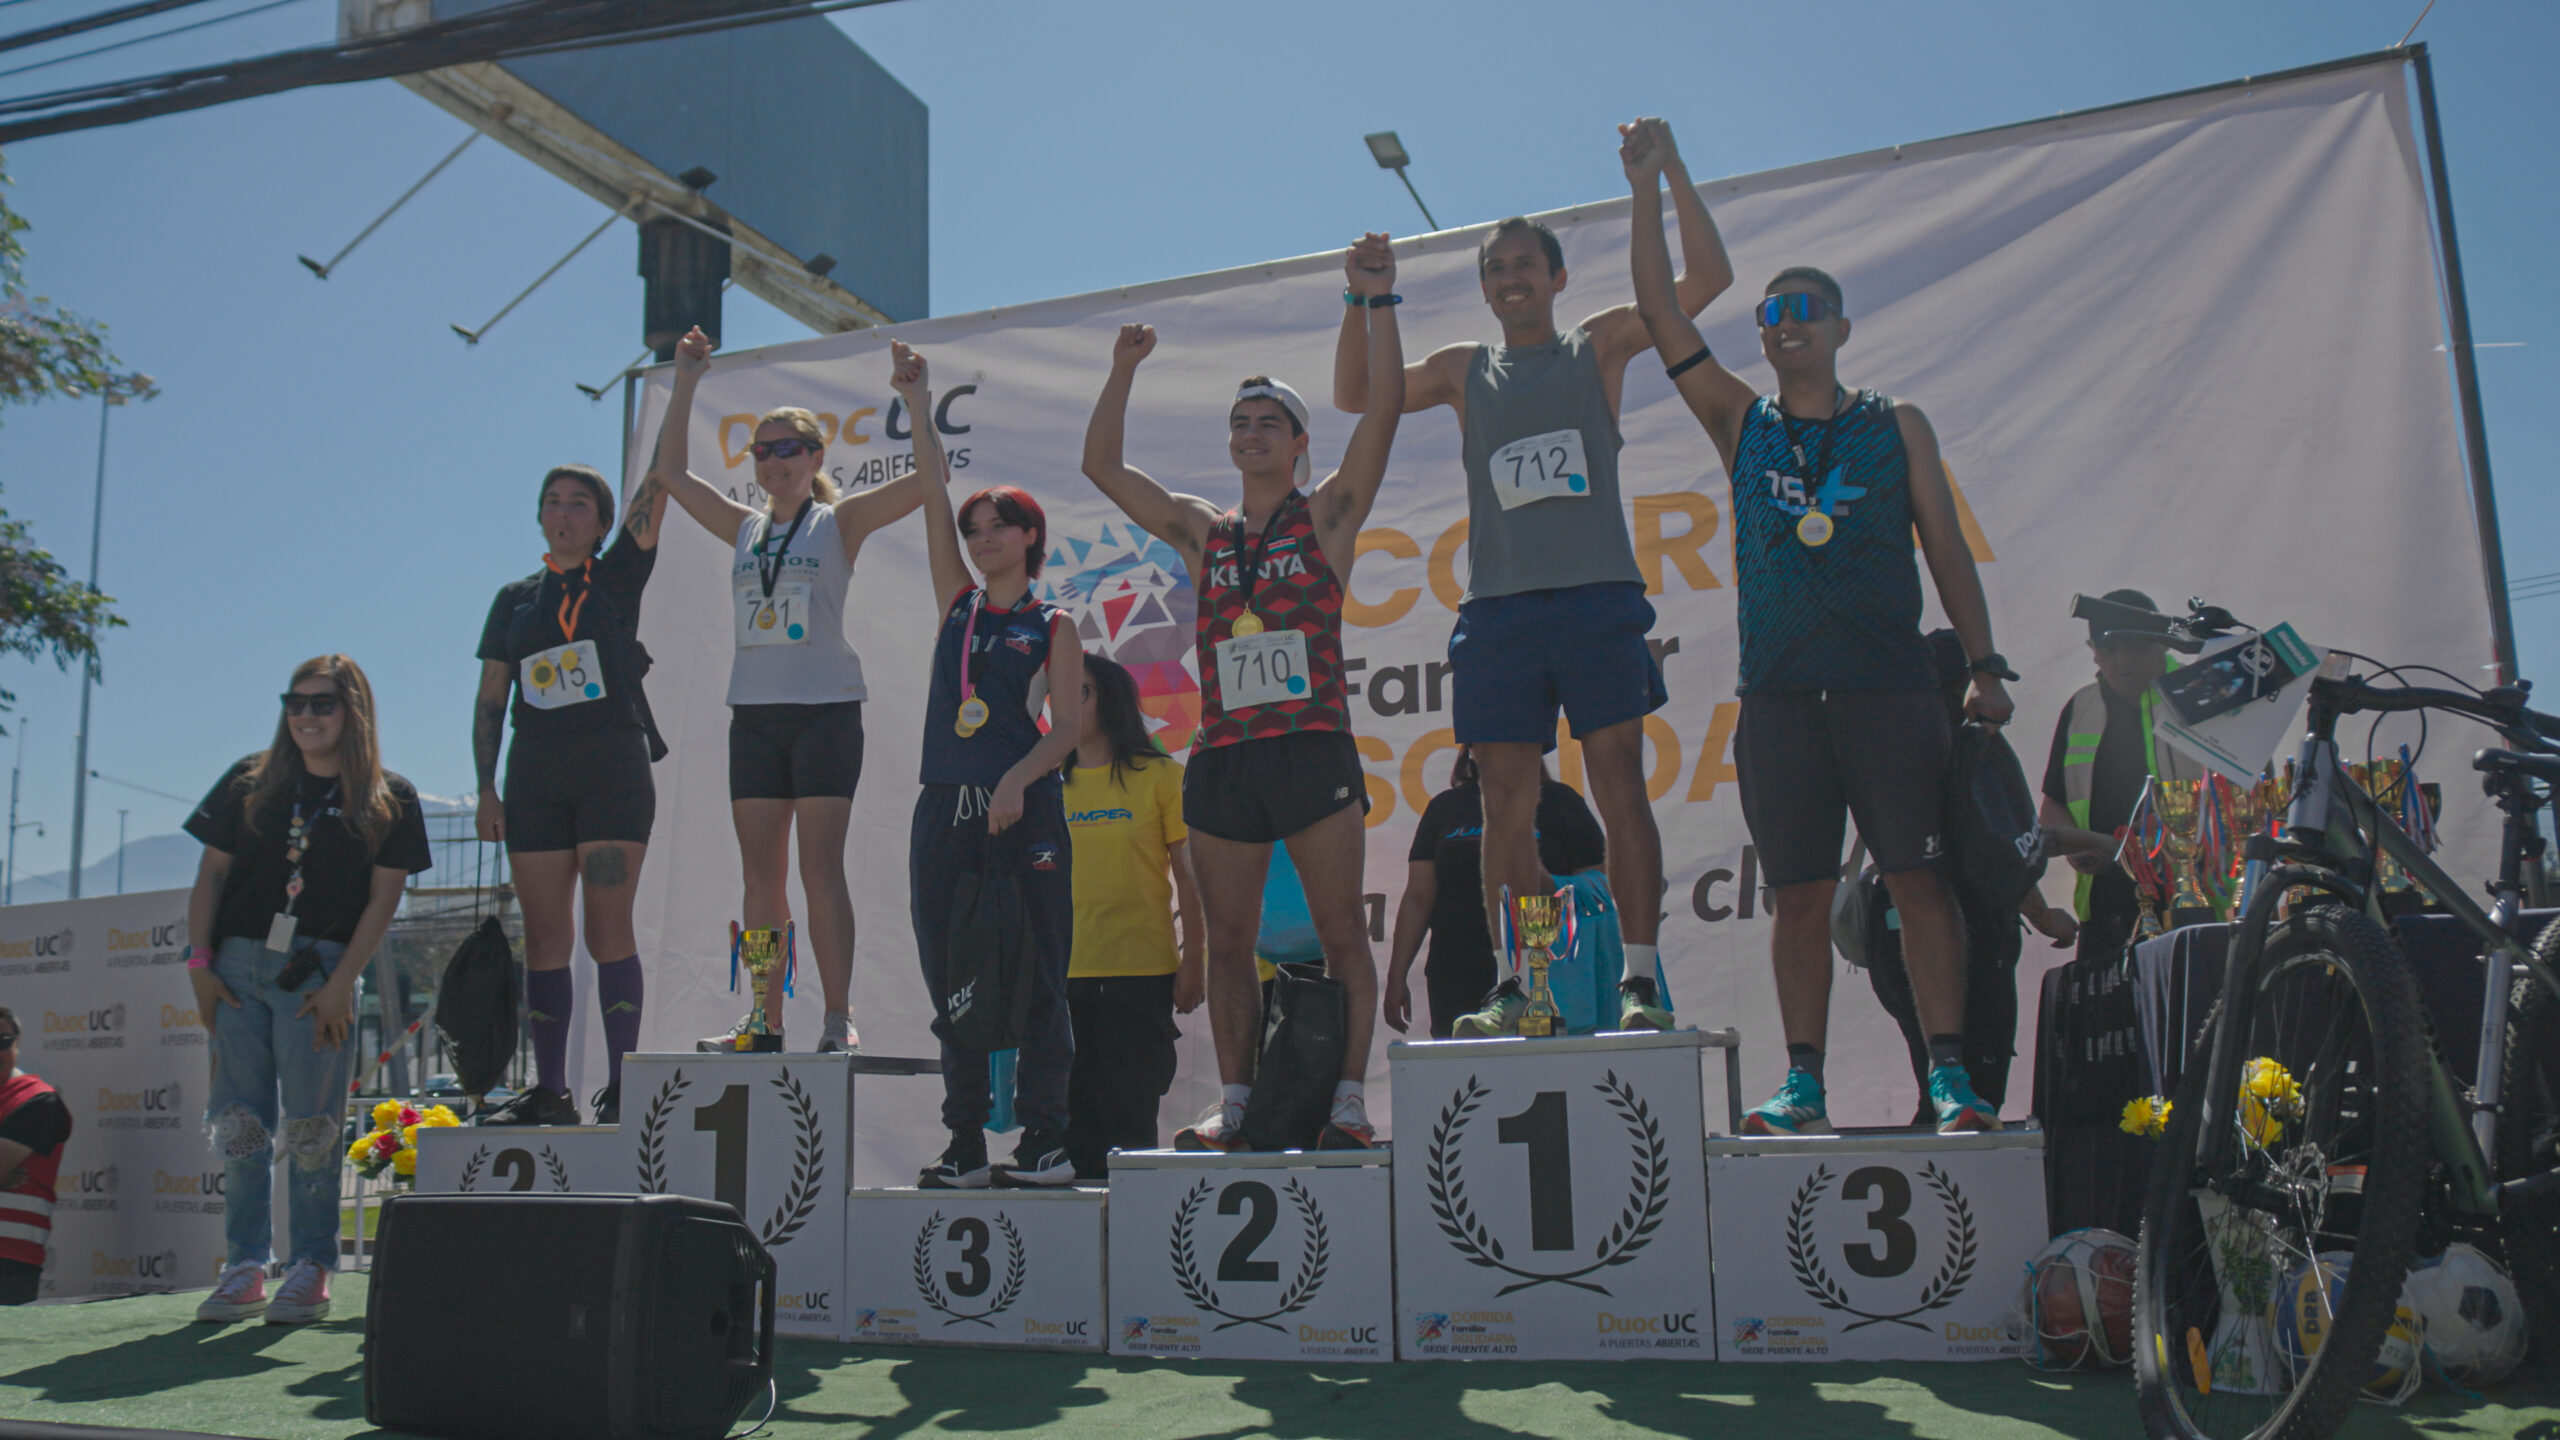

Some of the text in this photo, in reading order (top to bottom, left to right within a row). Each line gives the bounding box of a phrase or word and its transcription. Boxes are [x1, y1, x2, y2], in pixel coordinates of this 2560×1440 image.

[1505, 446, 1571, 488] 712
[1232, 648, 1291, 691] 710
[35, 935, 59, 957] UC
[107, 925, 175, 951] Duoc UC
[43, 1009, 112, 1034] Duoc UC
[97, 1088, 167, 1111] Duoc UC
[694, 1084, 749, 1220] 1
[81, 1171, 104, 1192] UC
[492, 1148, 536, 1192] 2
[1498, 1091, 1574, 1251] 1
[155, 1170, 225, 1195] Duoc UC
[1217, 1181, 1279, 1282] 2
[1842, 1167, 1916, 1278] 3
[138, 1254, 162, 1278] UC
[946, 1217, 991, 1297] 3
[806, 1292, 829, 1310] UC
[1025, 1318, 1088, 1336] Duoc UC
[1451, 1312, 1514, 1323] CORRIDA
[1598, 1312, 1697, 1334] Duoc UC
[1299, 1325, 1378, 1344] Duoc UC
[1453, 1333, 1516, 1344] SOLIDARIA
[1600, 1338, 1700, 1349] A PUERTAS ABIERTAS
[1945, 1322, 2004, 1342] Duoc
[1423, 1344, 1518, 1353] SEDE PUENTE ALTO
